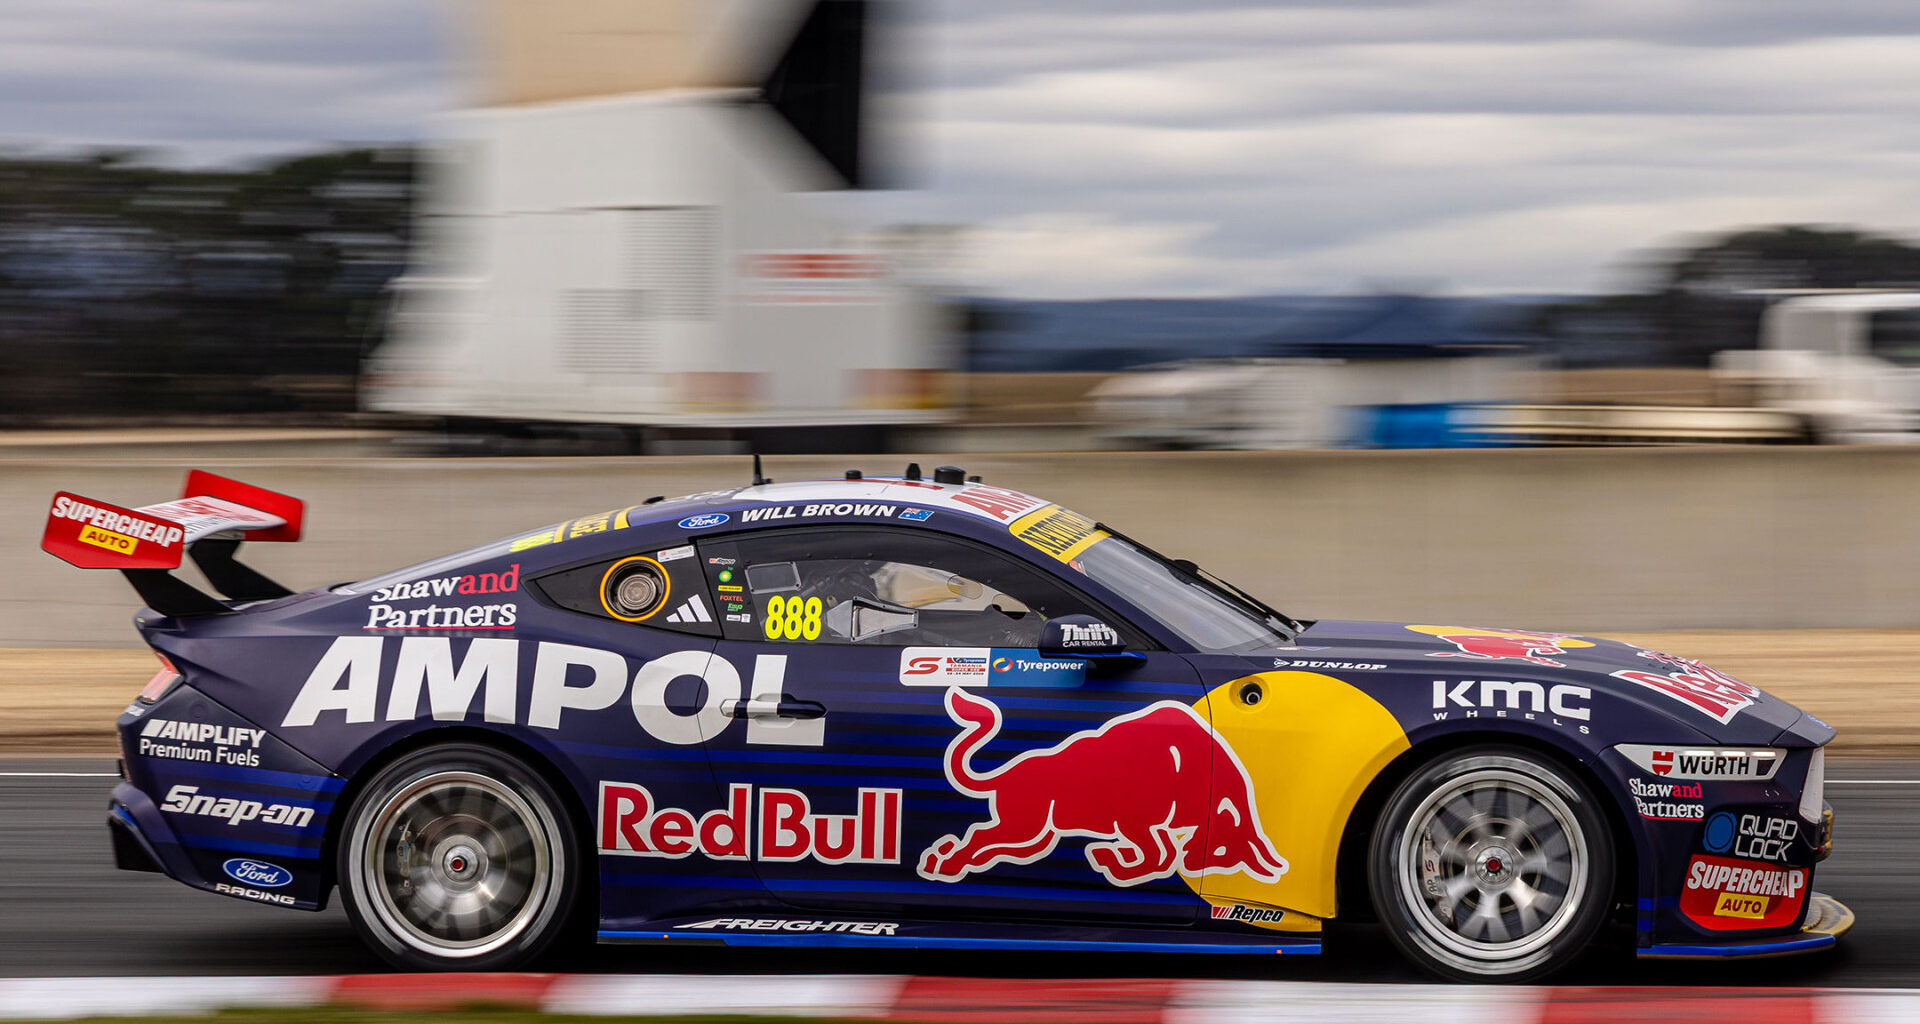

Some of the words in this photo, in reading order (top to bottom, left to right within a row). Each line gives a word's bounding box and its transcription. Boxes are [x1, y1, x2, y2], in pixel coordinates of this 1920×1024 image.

[52, 496, 184, 548] SUPERCHEAP
[687, 514, 720, 528] Ford
[741, 507, 796, 523] WILL
[801, 503, 896, 518] BROWN
[87, 530, 131, 550] AUTO
[720, 594, 744, 602] FOXTEL
[363, 603, 517, 629] Partners
[765, 595, 823, 641] 888
[1060, 623, 1118, 645] Thrifty
[1016, 659, 1084, 672] Tyrepower
[1289, 659, 1387, 671] DUNLOP
[280, 636, 825, 745] AMPOL
[157, 720, 266, 748] AMPLIFY
[139, 738, 212, 762] Premium
[215, 747, 260, 767] Fuels
[1678, 755, 1750, 775] WÜRTH
[160, 784, 316, 828] Snap-on
[1633, 796, 1705, 819] Partners
[598, 780, 751, 860] Red
[758, 787, 902, 865] Bull
[1739, 814, 1799, 841] QUAD
[1734, 836, 1793, 861] LOCK
[234, 861, 280, 885] Ford
[1686, 861, 1804, 898] SUPERCHEAP
[215, 882, 296, 905] RACING
[1228, 903, 1285, 923] Repco
[1720, 898, 1763, 914] AUTO
[706, 918, 900, 936] FREIGHTER
